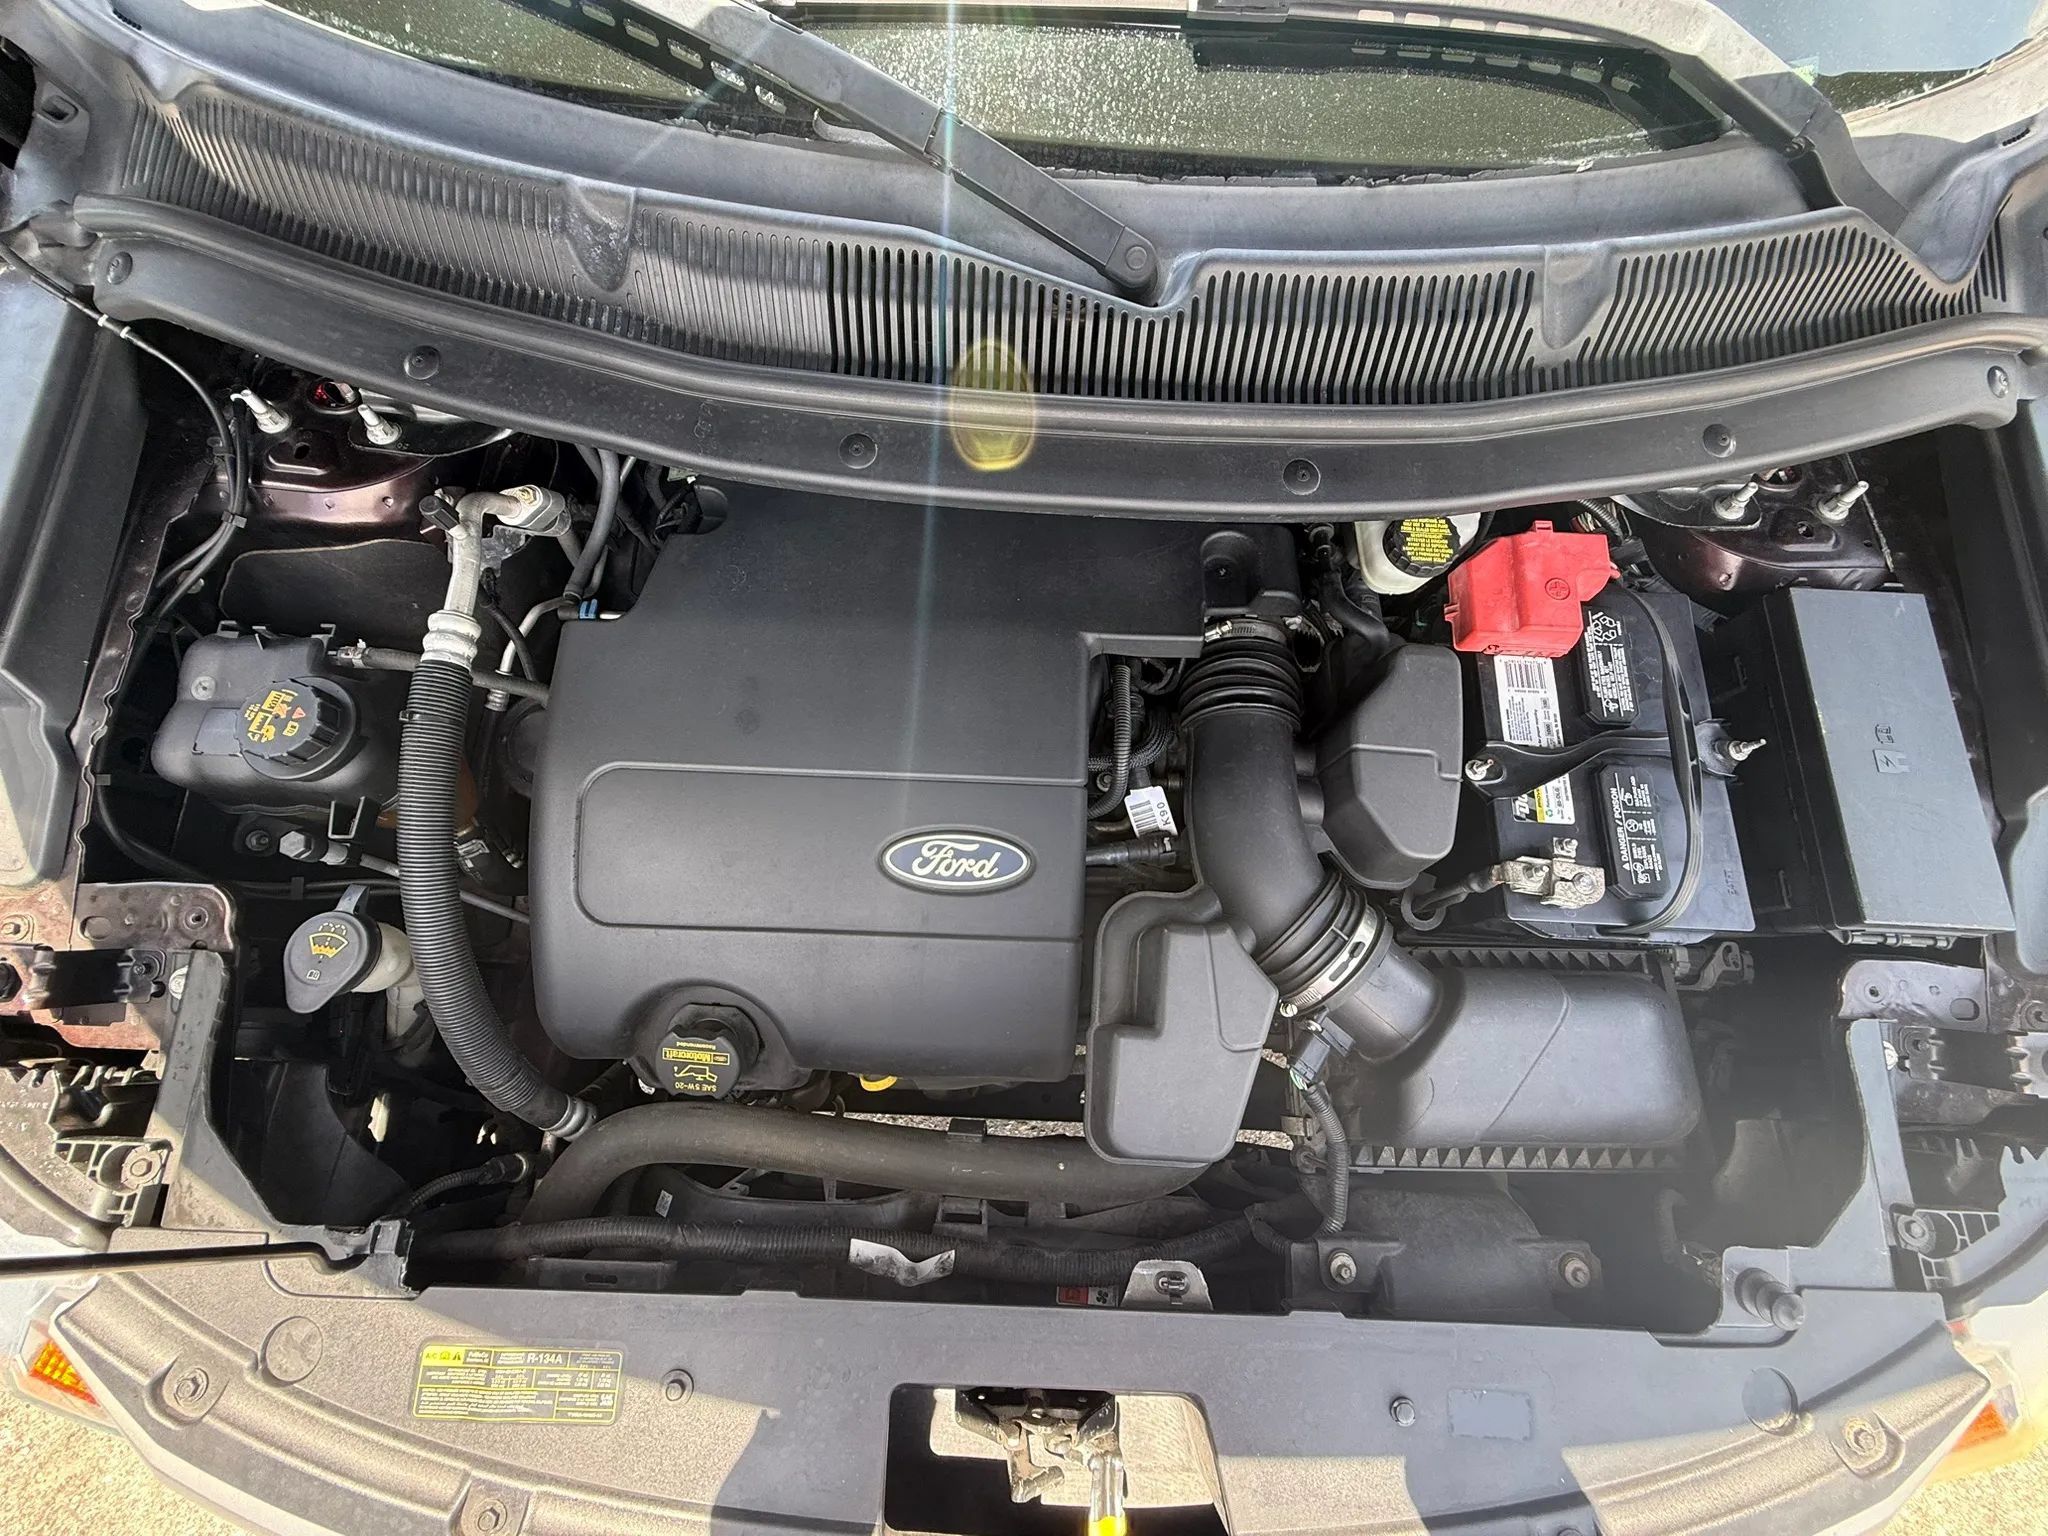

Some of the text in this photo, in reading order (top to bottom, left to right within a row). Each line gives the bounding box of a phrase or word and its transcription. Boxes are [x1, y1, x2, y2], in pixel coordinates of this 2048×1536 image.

[1156, 801, 1171, 826] K90
[1609, 787, 1622, 818] POISON
[1616, 826, 1629, 861] DANGER
[911, 840, 1001, 880] Ford
[666, 1050, 711, 1062] Motorcraft
[675, 1081, 717, 1092] SAE 5W-20
[527, 1353, 563, 1364] R-134A
